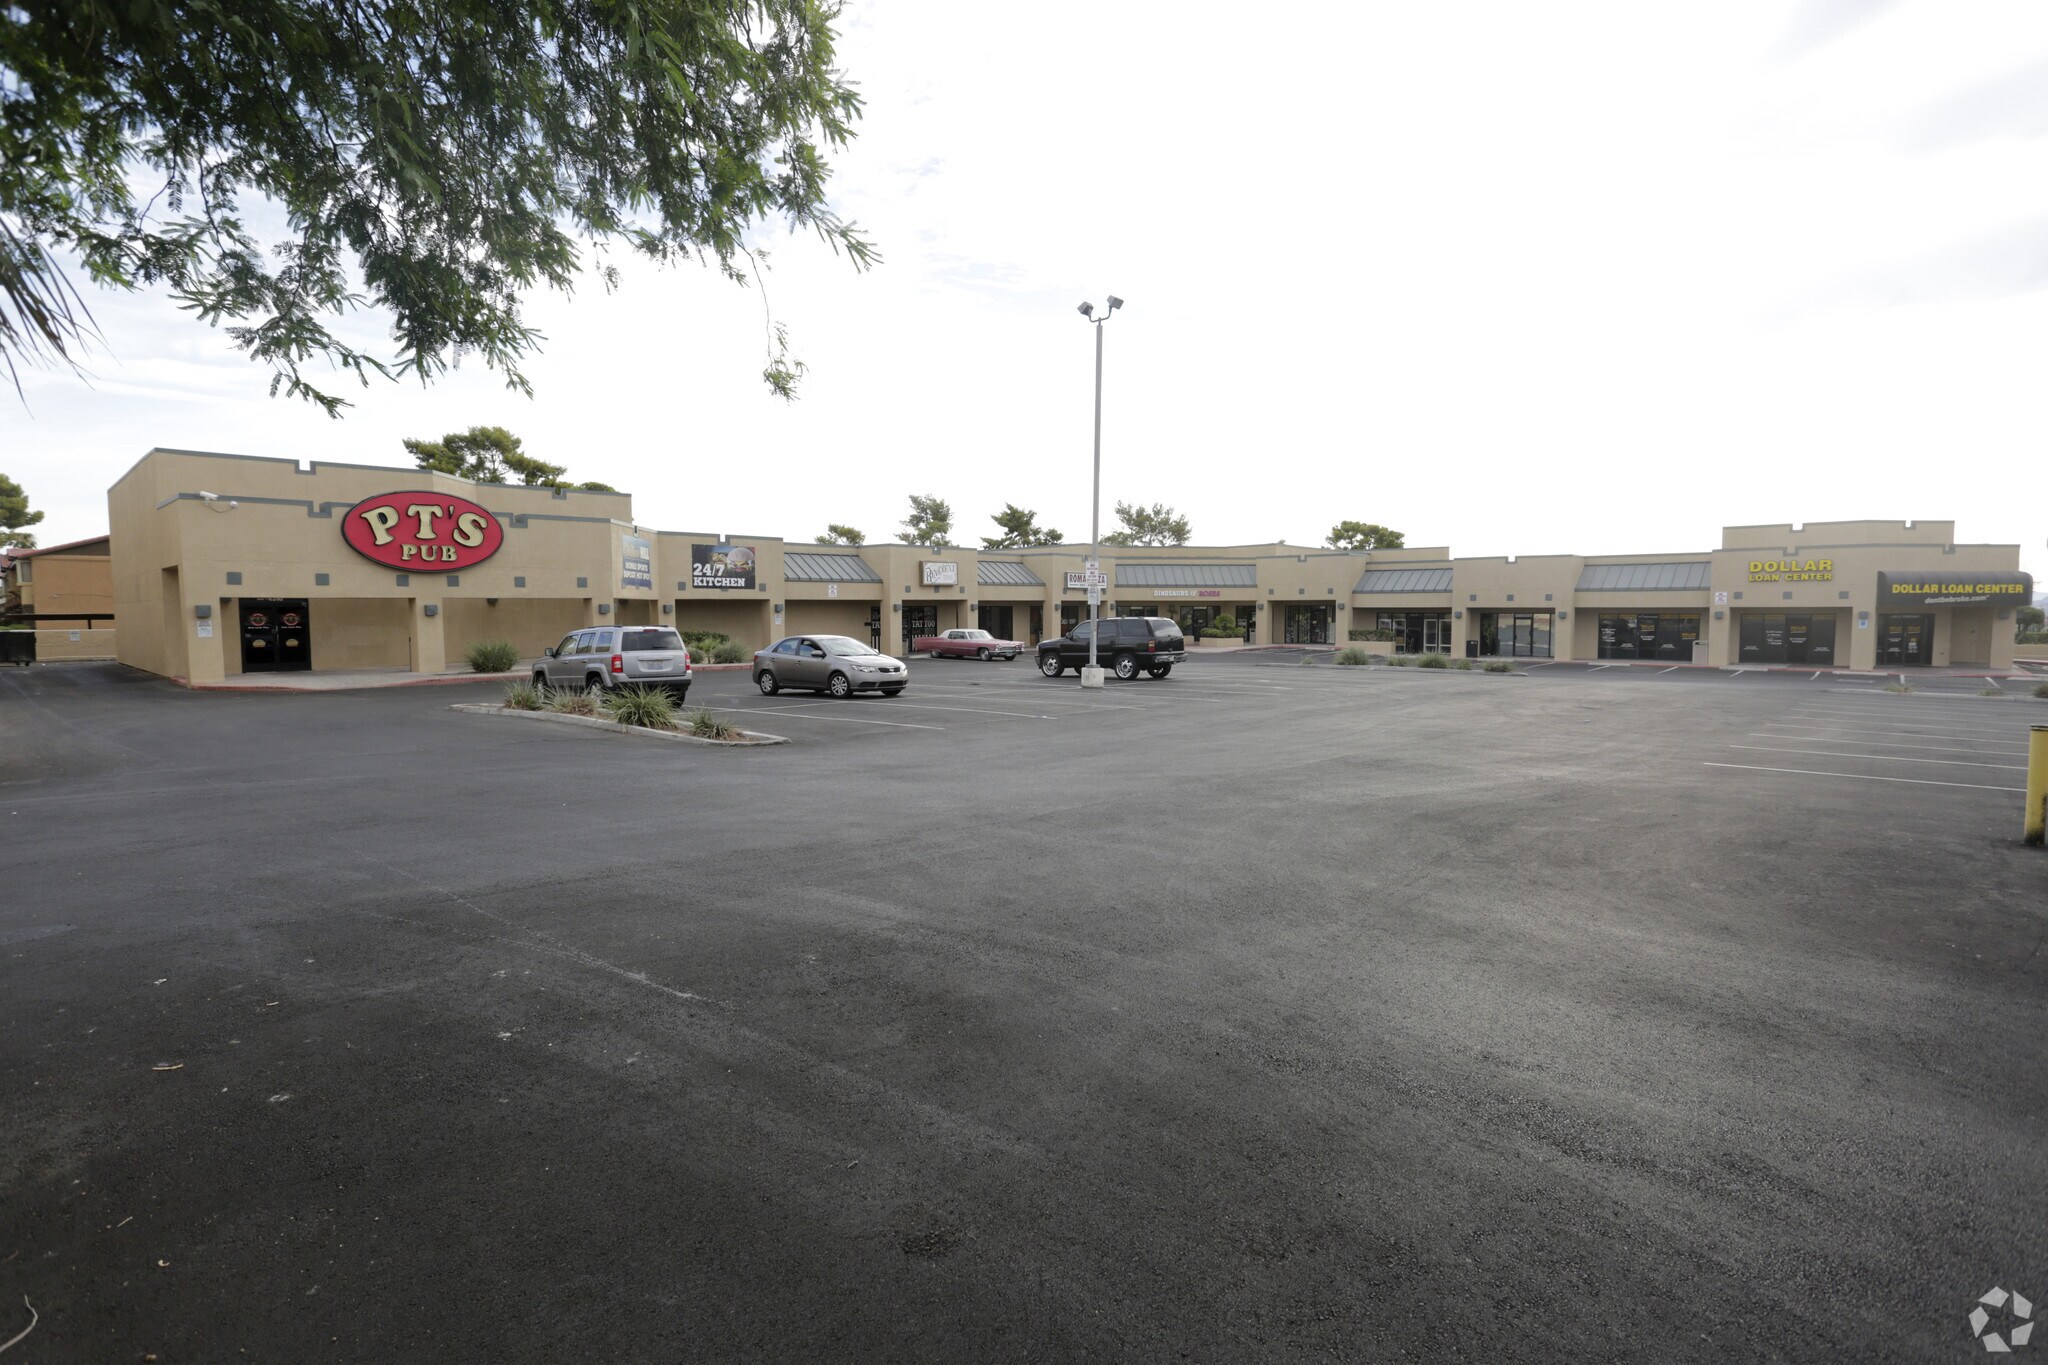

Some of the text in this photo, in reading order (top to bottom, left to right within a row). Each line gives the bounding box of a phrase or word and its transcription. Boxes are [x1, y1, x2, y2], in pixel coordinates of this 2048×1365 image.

[360, 504, 488, 547] PT'S
[401, 543, 458, 561] PUB
[693, 563, 725, 576] 24/7
[1748, 560, 1833, 572] DOLLAR
[693, 577, 745, 587] KITCHEN
[1748, 573, 1833, 582] LOAN CENTER
[1892, 584, 2024, 594] DOLLAR LOAN CENTER
